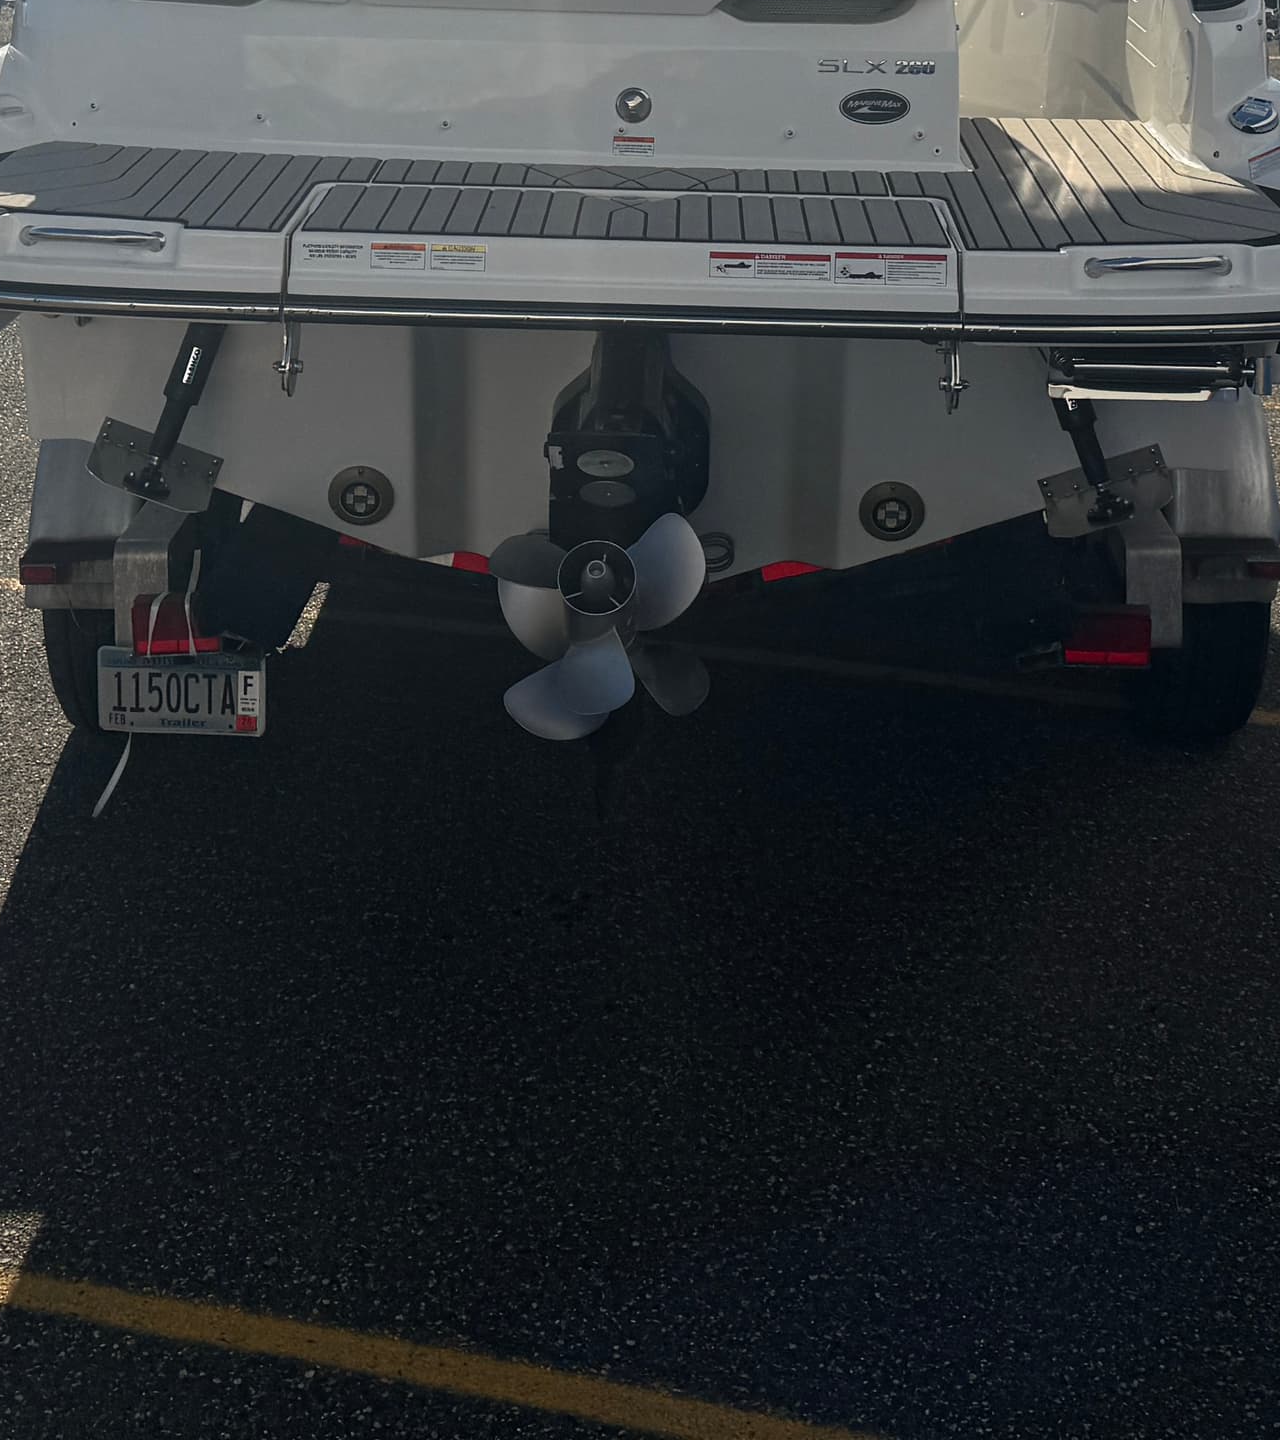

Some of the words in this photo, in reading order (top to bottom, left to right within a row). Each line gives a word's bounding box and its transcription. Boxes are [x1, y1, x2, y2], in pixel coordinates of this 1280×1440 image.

[817, 58, 888, 74] SLX
[112, 671, 236, 715] 1150CTA
[243, 675, 254, 696] F
[108, 712, 126, 725] FEB
[159, 717, 207, 728] Trailer
